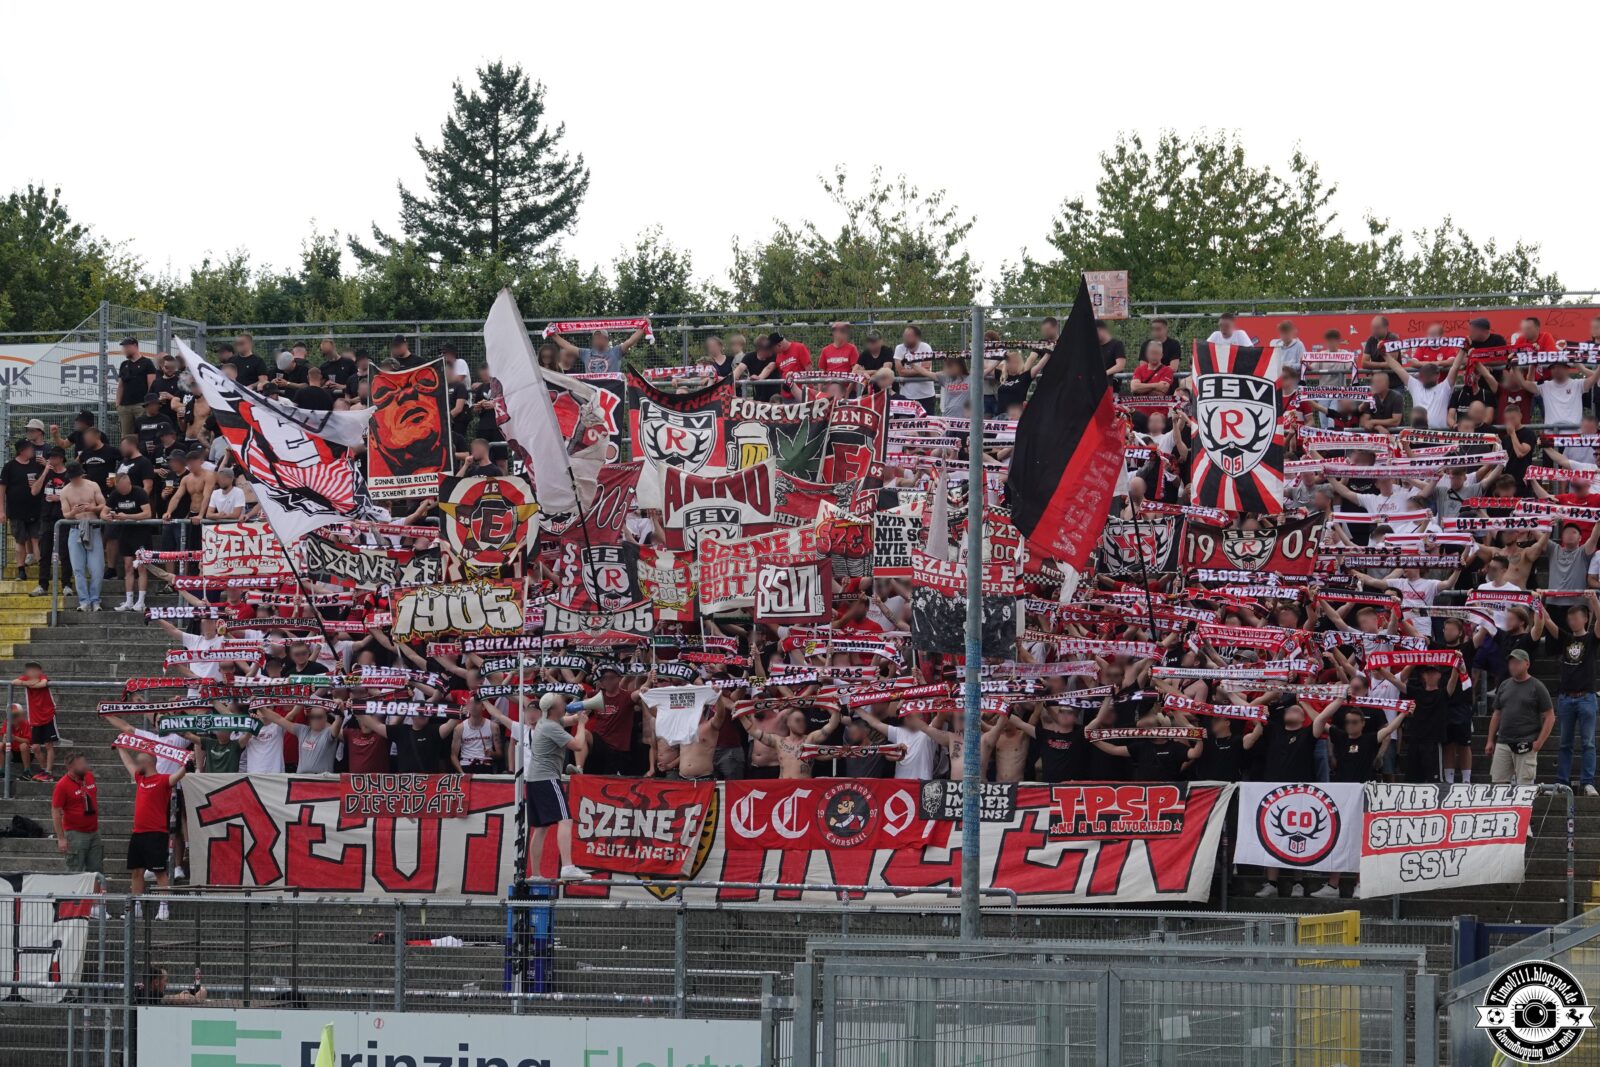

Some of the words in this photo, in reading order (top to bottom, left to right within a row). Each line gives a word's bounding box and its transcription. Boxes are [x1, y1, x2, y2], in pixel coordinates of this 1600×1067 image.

[1384, 336, 1467, 354] KREUZEICHE
[1517, 351, 1570, 366] BLOCK
[1202, 379, 1268, 400] SSV
[730, 398, 829, 421] FOREVER
[1219, 409, 1245, 440] R
[664, 427, 688, 452] R
[1223, 456, 1243, 472] 05
[1410, 456, 1483, 466] STUTTGART
[374, 478, 394, 487] SONNE
[396, 476, 412, 485] ÜBER
[380, 489, 407, 498] SCHEINT
[408, 488, 416, 496] JA
[417, 488, 427, 496] SO
[459, 516, 471, 526] 20
[690, 507, 739, 523] SSV
[876, 515, 906, 528] WIR
[798, 528, 816, 554] E
[875, 528, 903, 542] NIE
[1228, 530, 1272, 538] SSV
[203, 530, 276, 563] SZENE
[875, 543, 908, 555] WIE
[1241, 540, 1258, 554] R
[604, 568, 624, 589] R
[638, 560, 685, 584] SZENE
[1000, 566, 1017, 582] E
[1197, 568, 1252, 583] BLOCK
[227, 578, 269, 587] SZENE
[270, 577, 278, 587] E
[914, 570, 1015, 593] REUTLIGEN
[651, 587, 688, 601] 2005
[700, 575, 747, 604] SEIT
[150, 607, 193, 619] BLOCK
[211, 606, 219, 618] E
[394, 588, 523, 638] 1905
[1173, 605, 1218, 622] SZENE
[1173, 620, 1183, 629] E
[1218, 628, 1272, 640] REUTLINGEN
[1273, 633, 1285, 641] 05
[543, 655, 586, 668] POWER
[1264, 660, 1307, 671] SZENE
[1393, 652, 1454, 664] STUTTGART
[650, 663, 693, 679] POWER
[537, 683, 581, 695] POWER
[879, 681, 895, 690] 97
[1025, 680, 1036, 693] E
[365, 702, 419, 715] BLOCK
[436, 704, 448, 717] E
[999, 702, 1009, 713] E
[1213, 704, 1258, 719] SZENE
[213, 716, 259, 731] GALLEN
[153, 743, 185, 762] SZENE
[351, 773, 429, 793] ONORE
[436, 772, 462, 793] AI
[345, 793, 466, 814] DIFFIDATI
[1053, 785, 1181, 824] TPSP
[1365, 782, 1440, 812] WIR
[1443, 783, 1540, 810] ALLE
[578, 796, 676, 843] SZENE
[817, 809, 825, 818] 19
[869, 808, 878, 818] 97
[1286, 810, 1313, 828] CO
[1058, 821, 1073, 834] NO
[1078, 822, 1087, 833] A
[1092, 821, 1107, 833] LA
[1110, 820, 1172, 833] AUTORIDAD
[1368, 815, 1446, 848] SIND
[1450, 811, 1520, 842] DER
[586, 841, 689, 861] REUTLINGEN
[1399, 848, 1468, 882] SSV
